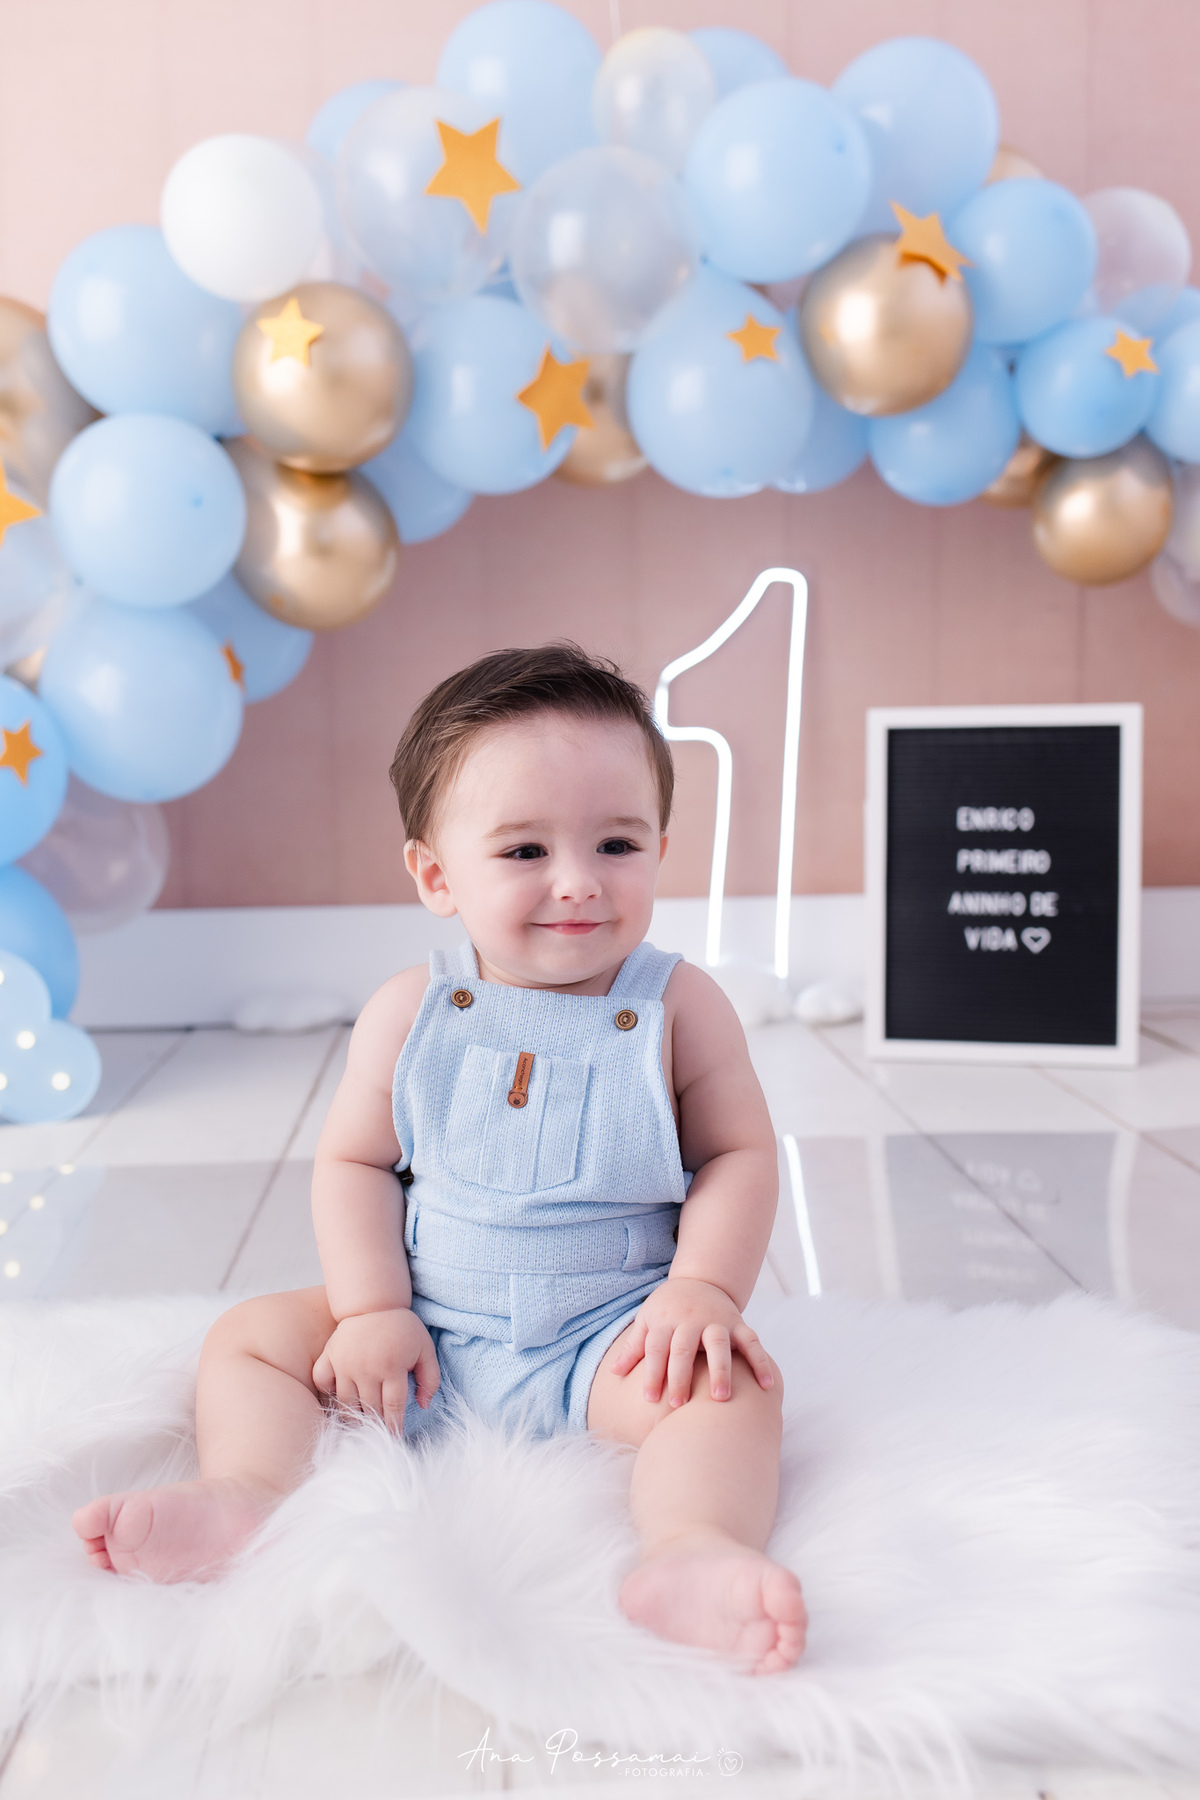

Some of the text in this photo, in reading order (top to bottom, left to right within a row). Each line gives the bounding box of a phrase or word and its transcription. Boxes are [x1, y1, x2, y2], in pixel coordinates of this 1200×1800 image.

[655, 567, 808, 979] 1
[956, 806, 1035, 832] ENRICO
[956, 848, 1051, 874] PRIMEIRO
[947, 890, 1059, 917] ANINHO DE
[964, 926, 1018, 952] VIDA
